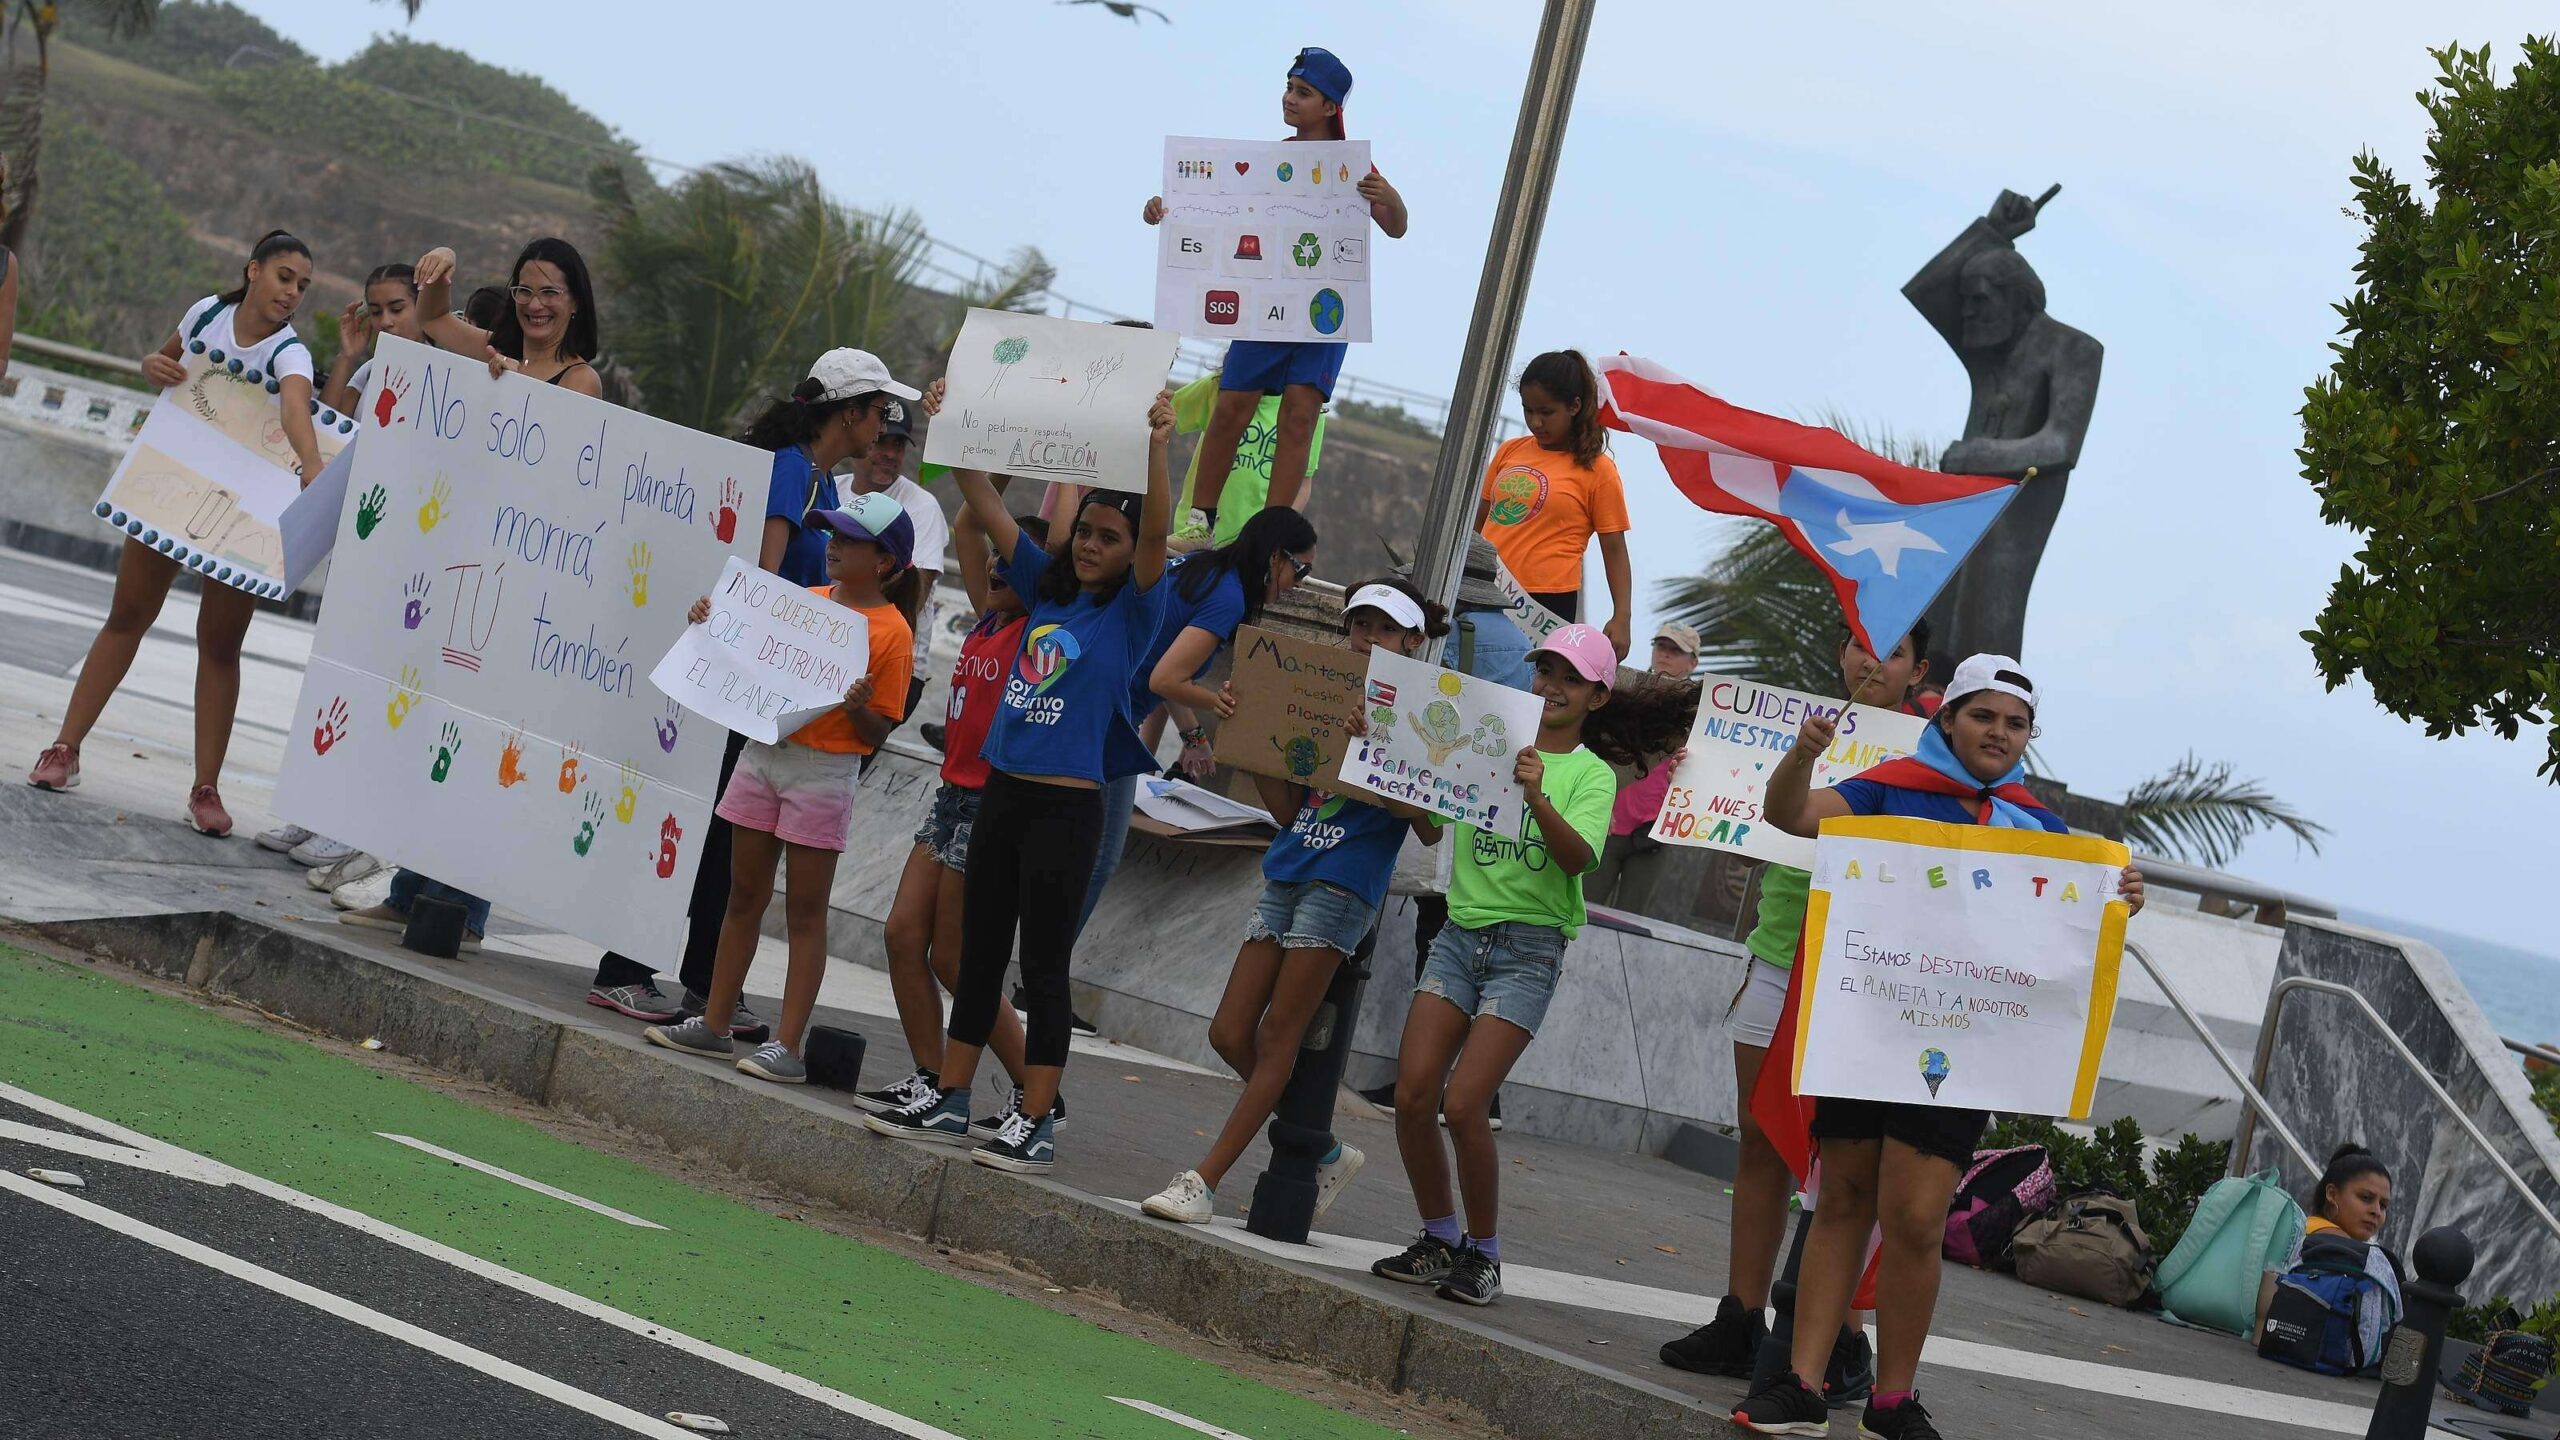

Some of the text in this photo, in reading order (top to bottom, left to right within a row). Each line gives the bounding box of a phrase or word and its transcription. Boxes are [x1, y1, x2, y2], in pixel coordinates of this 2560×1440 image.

[1181, 238, 1203, 253] Es
[1209, 301, 1235, 315] SOS
[961, 409, 979, 430] No
[987, 418, 1028, 442] pedimos
[415, 363, 697, 526] No solo el planeta
[962, 438, 1098, 468] pedimos ACCIÓN
[444, 562, 506, 651] TÚ
[726, 571, 853, 648] ¡NO QUEREMOS
[708, 610, 848, 694] QUE DESTRUYAN
[685, 657, 714, 689] EL
[1293, 684, 1345, 705] nuestro
[1025, 710, 1061, 727] 2017
[1704, 716, 1796, 752] NUESTRO
[1668, 786, 1765, 822] ES NUES
[1302, 836, 1341, 850] 2017
[1659, 811, 1751, 847] HOGAR
[1845, 859, 2079, 903] ALERTA
[1919, 954, 2037, 988] DESTRUYENDO
[1840, 975, 2029, 1018] EL PLANETA Y A NOSOTROS
[1900, 1009, 1971, 1030] MISMOS
